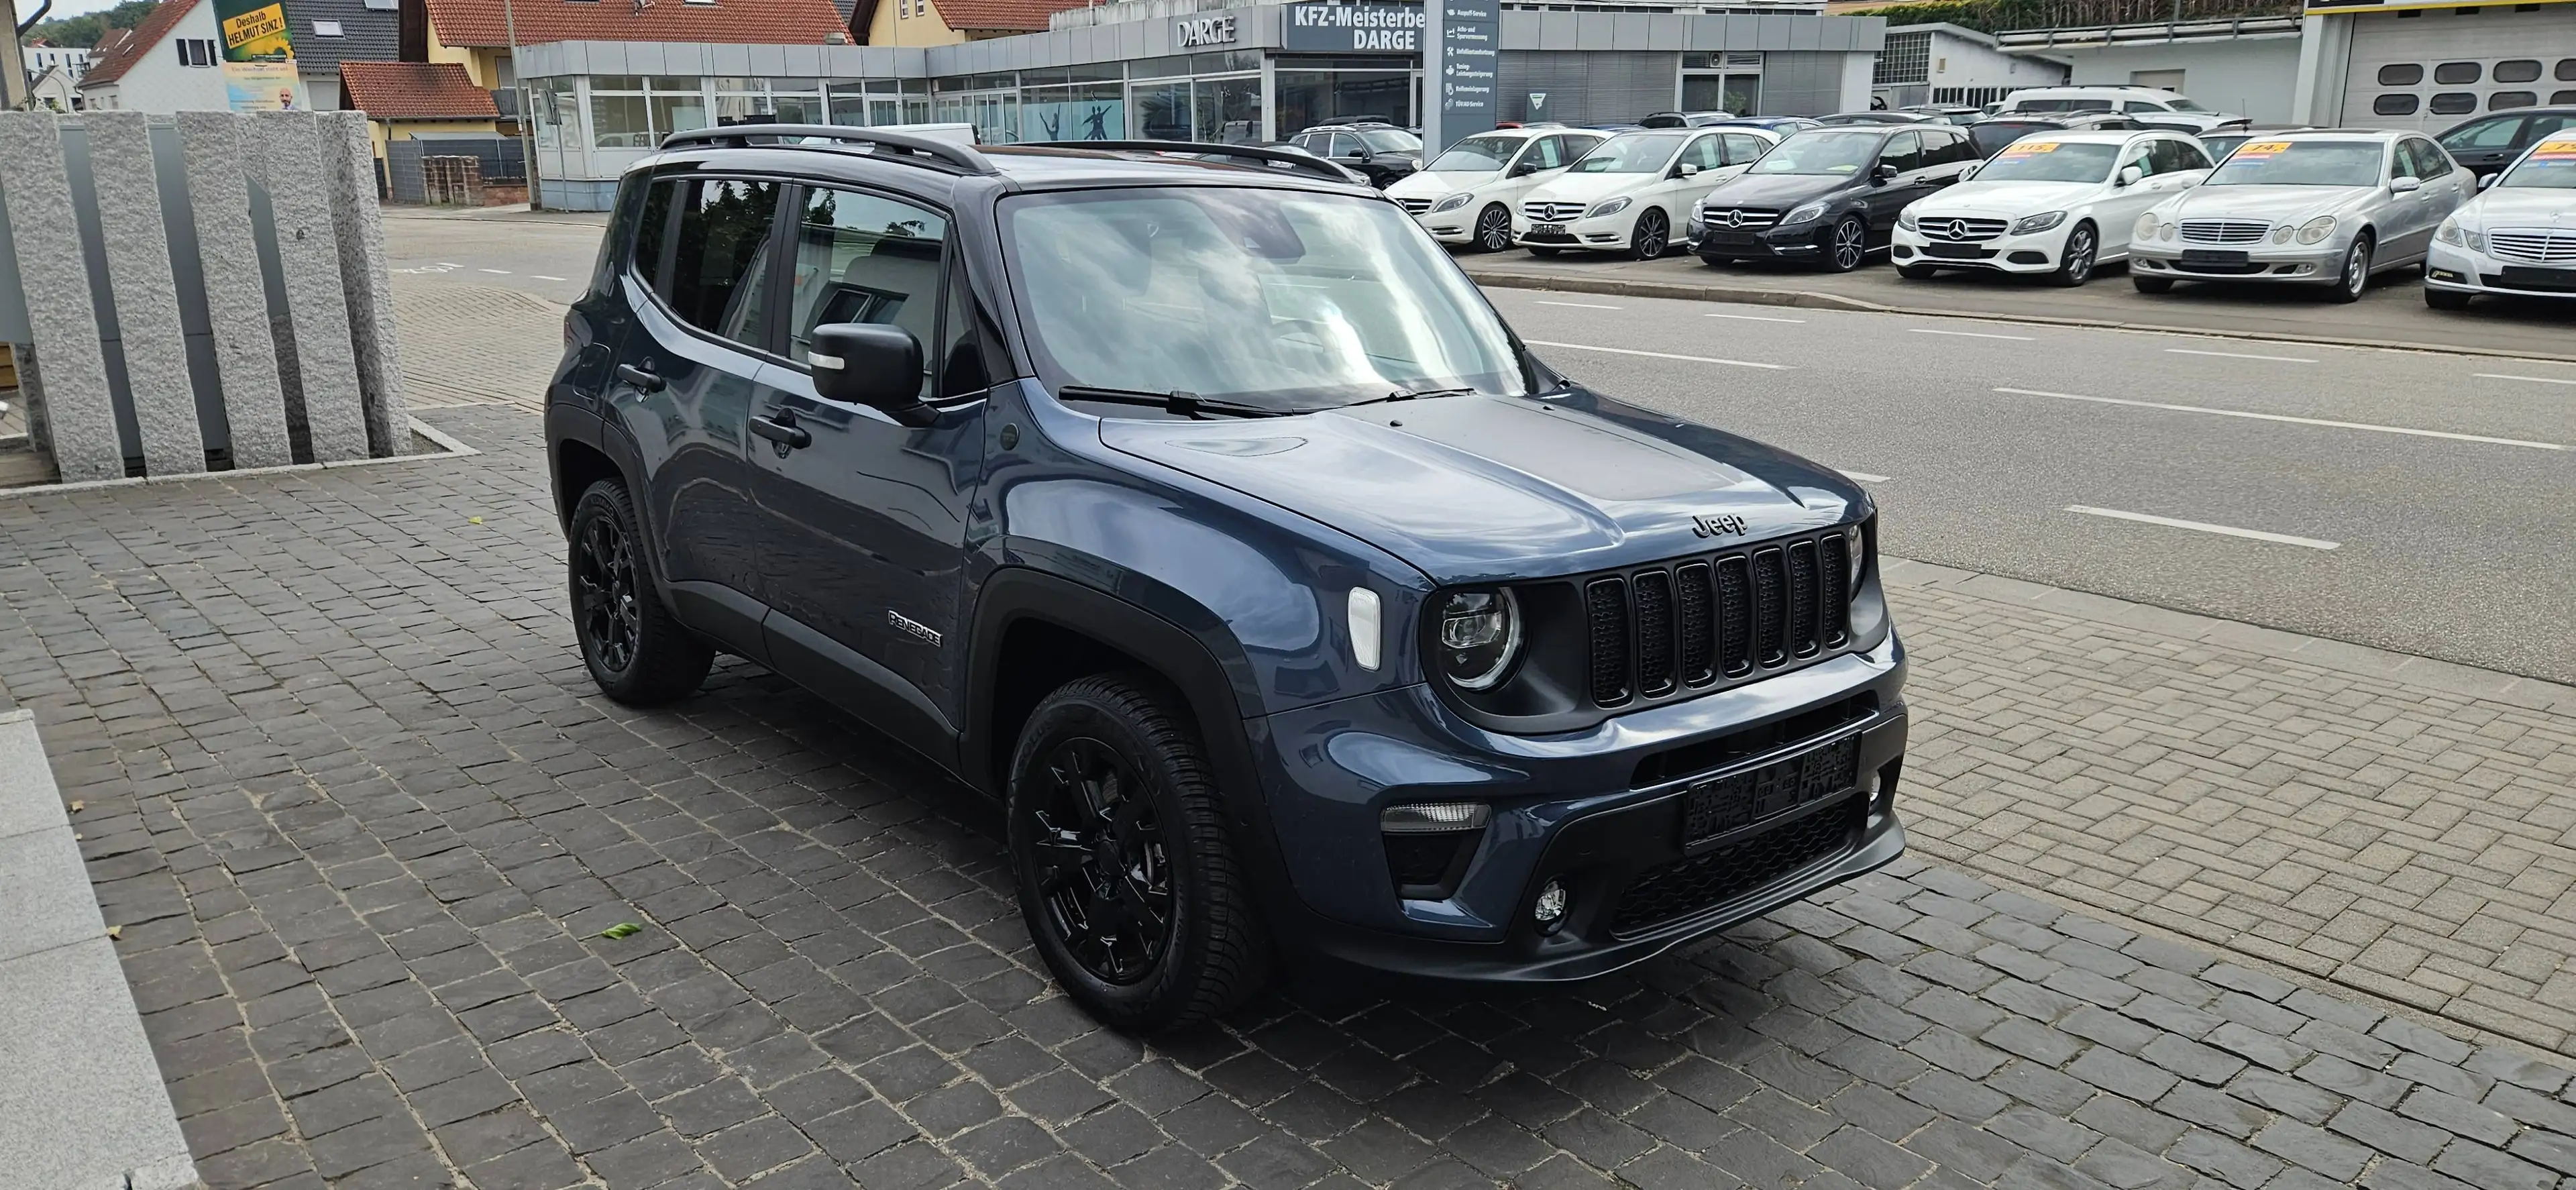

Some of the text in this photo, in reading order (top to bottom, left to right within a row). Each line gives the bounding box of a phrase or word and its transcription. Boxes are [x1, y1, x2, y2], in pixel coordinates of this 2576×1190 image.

[236, 11, 266, 28] Deshalb
[1177, 15, 1236, 47] DARGE
[228, 24, 260, 46] HELMUT
[1354, 30, 1415, 50] DARGE
[1691, 514, 1748, 539] Jeep
[888, 609, 943, 647] RENEGADE
